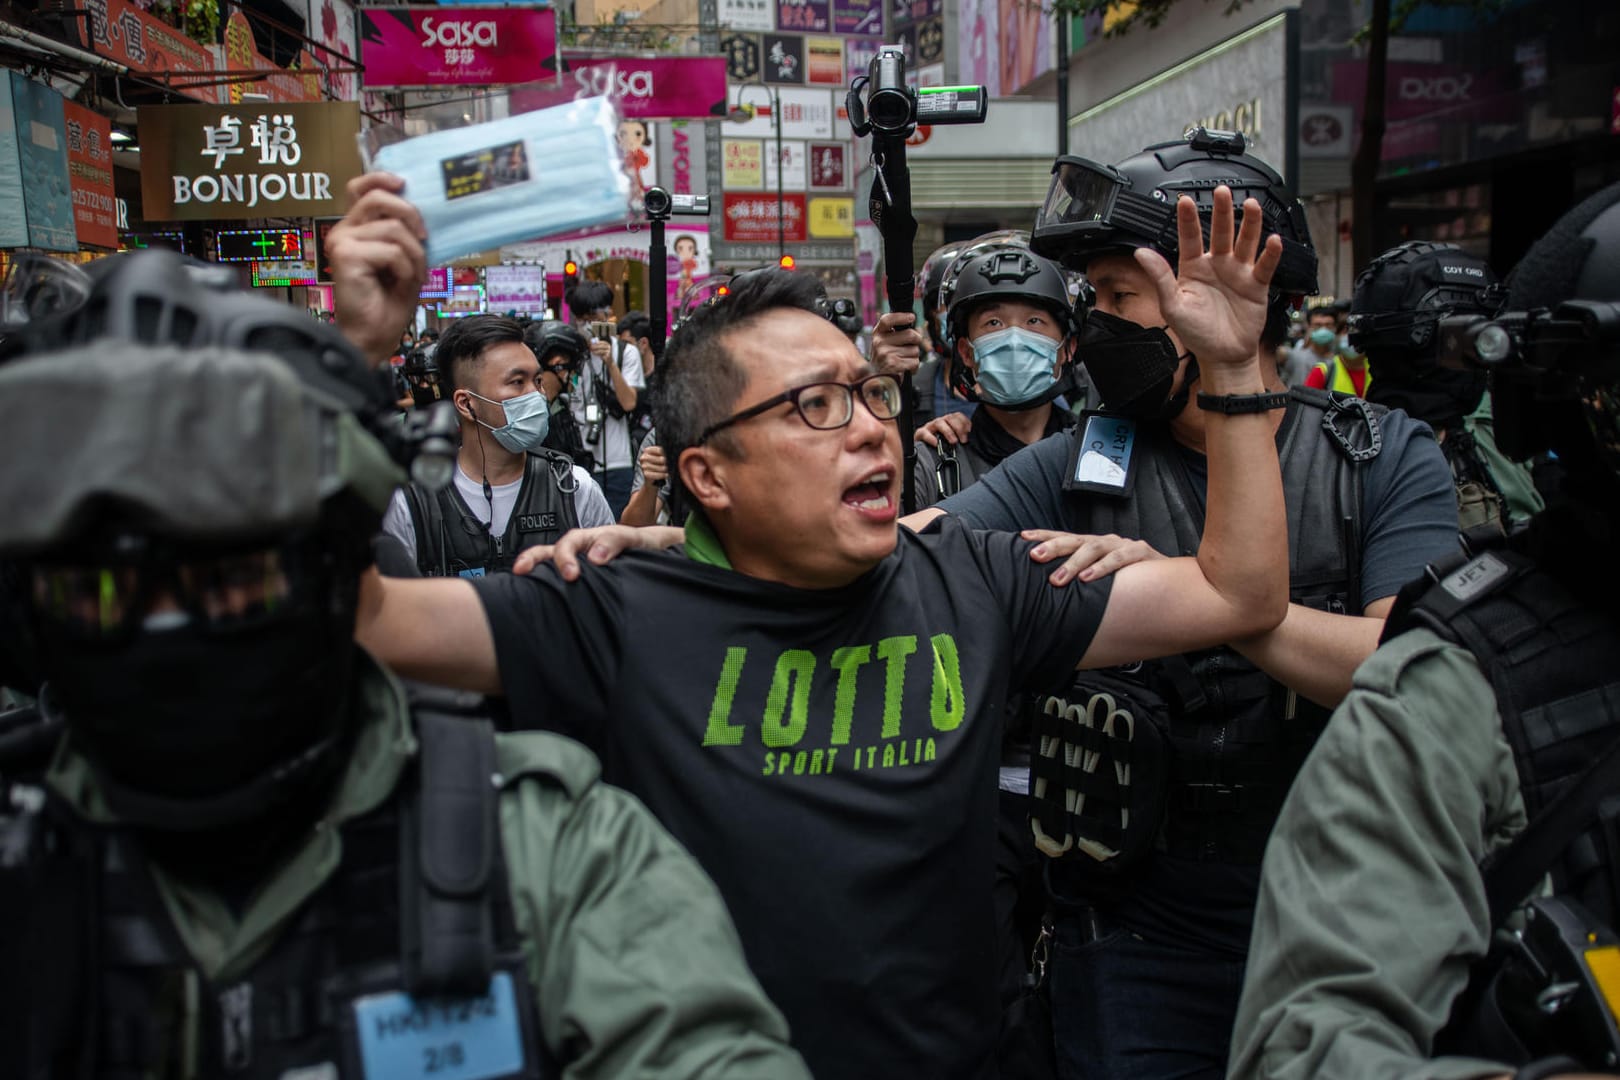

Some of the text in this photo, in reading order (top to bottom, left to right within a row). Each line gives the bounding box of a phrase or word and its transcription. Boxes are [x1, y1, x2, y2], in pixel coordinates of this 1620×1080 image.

[172, 172, 333, 207] BONJOUR
[521, 514, 556, 529] POLICE
[1458, 561, 1487, 587] JET
[702, 633, 965, 747] LOTTO
[763, 738, 936, 776] SPORT ITALIA
